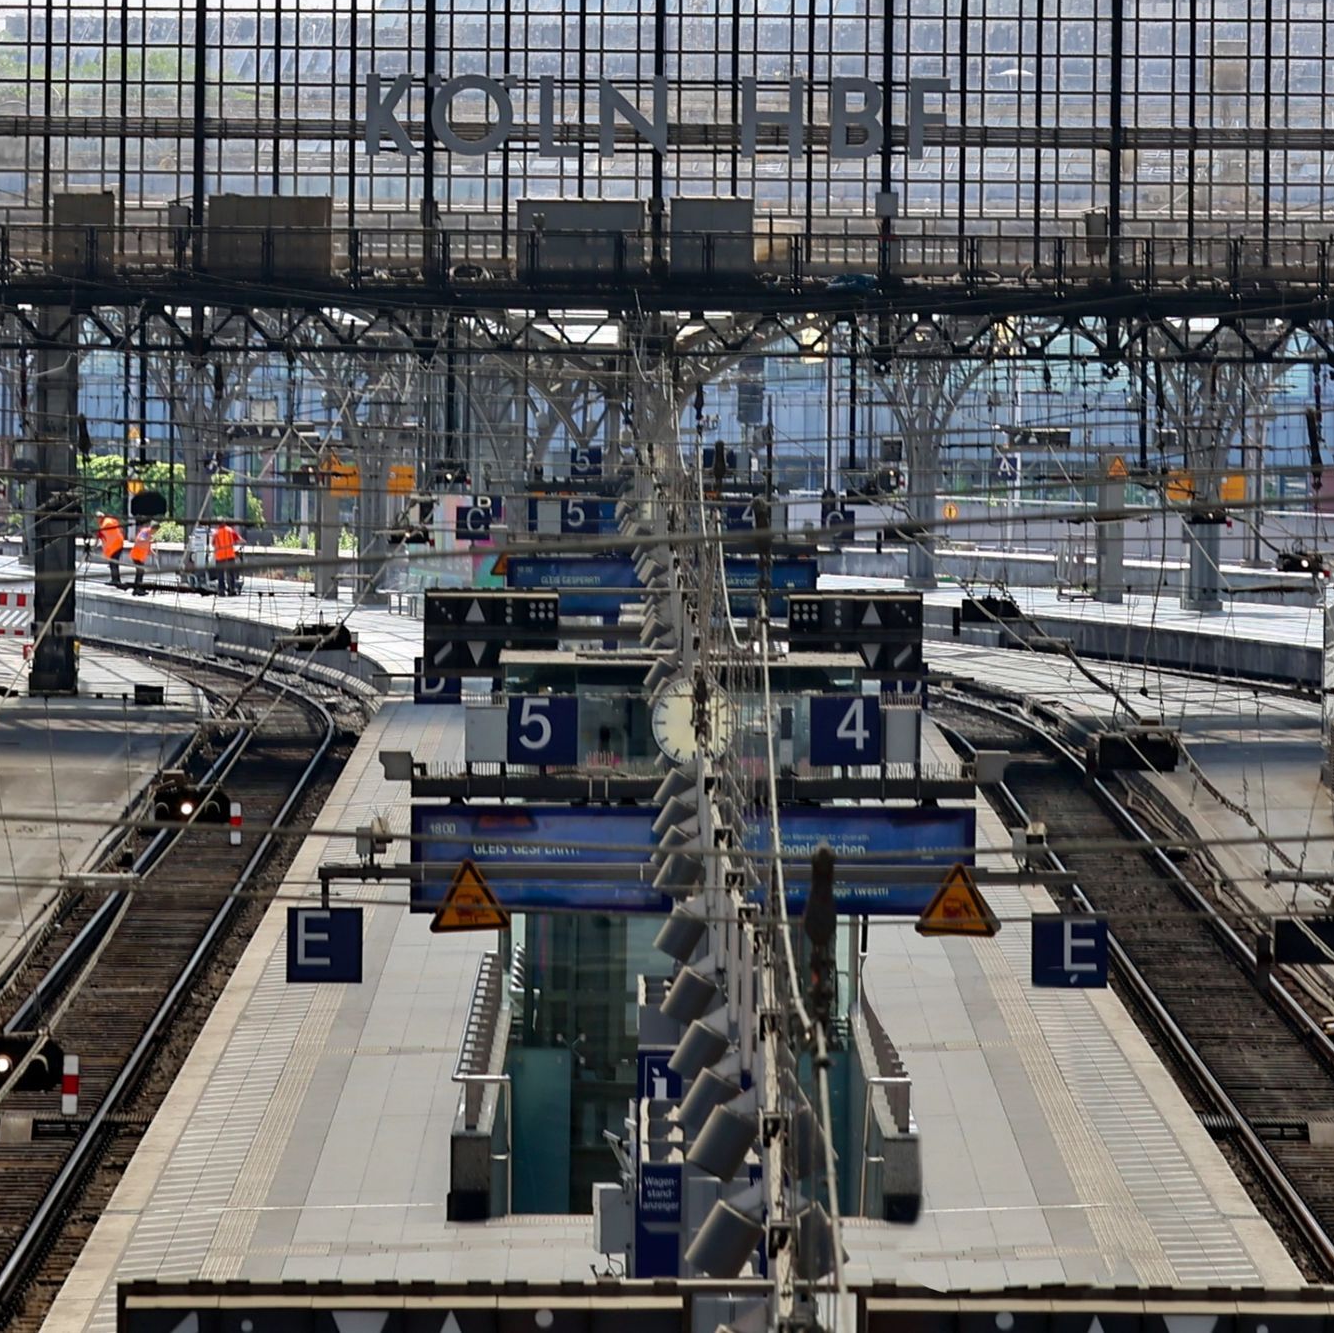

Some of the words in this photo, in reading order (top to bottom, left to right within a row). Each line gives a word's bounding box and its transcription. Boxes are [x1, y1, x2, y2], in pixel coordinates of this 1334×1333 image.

[365, 73, 667, 158] KÖLN
[741, 75, 951, 160] HBF
[575, 448, 590, 472] 5
[467, 508, 485, 532] C
[567, 498, 586, 527] 5
[519, 697, 552, 750] 5
[836, 698, 870, 751] 4
[297, 910, 331, 966] E
[1063, 918, 1098, 972] E
[644, 1176, 678, 1190] Wagen-
[647, 1188, 675, 1199] stand-
